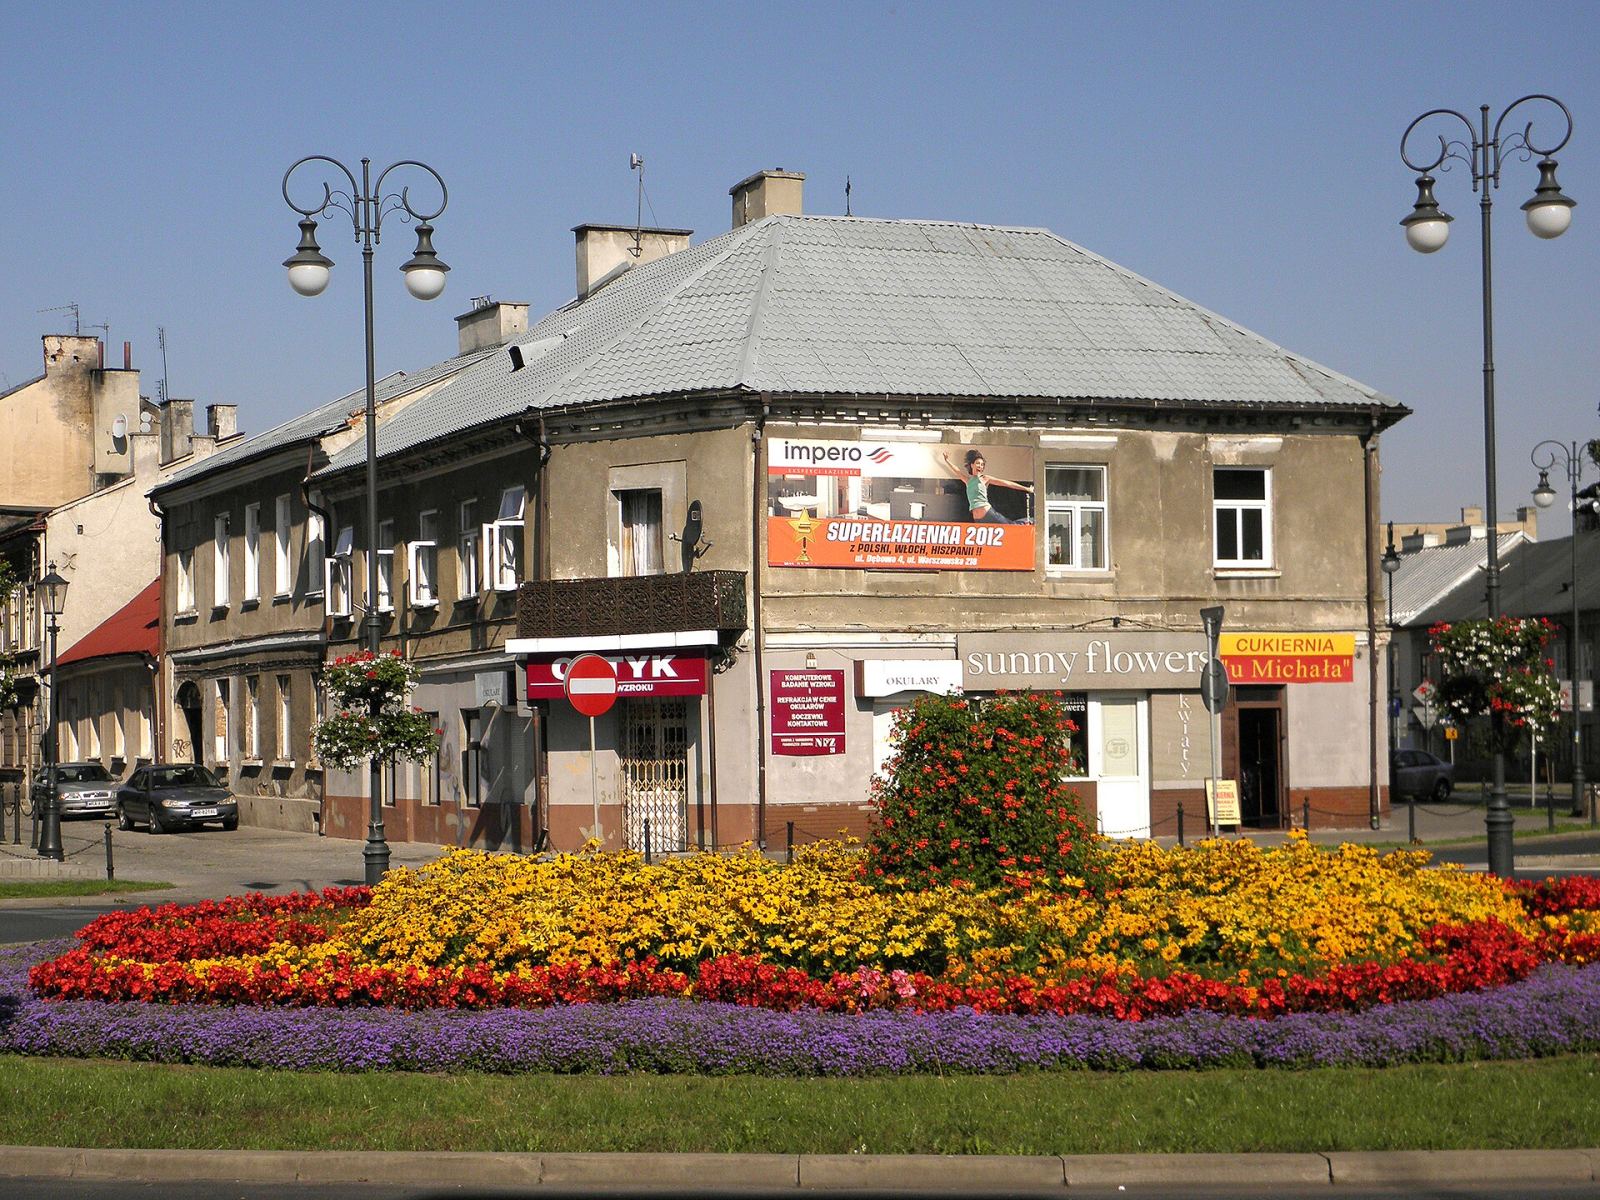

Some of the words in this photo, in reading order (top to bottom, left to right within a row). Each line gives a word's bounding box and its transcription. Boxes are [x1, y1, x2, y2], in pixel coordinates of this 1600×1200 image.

[784, 441, 862, 464] impero
[826, 522, 960, 546] SUPERŁAZIENKA
[964, 526, 1005, 547] 2012
[857, 543, 892, 555] POLSKI,
[894, 545, 929, 556] WŁOCH,
[931, 545, 975, 556] HISZPANII
[976, 547, 983, 556] !!
[1236, 638, 1335, 653] CUKIERNIA
[551, 654, 679, 681] OTYK
[967, 651, 1079, 684] sunny
[886, 677, 940, 686] OKULARY
